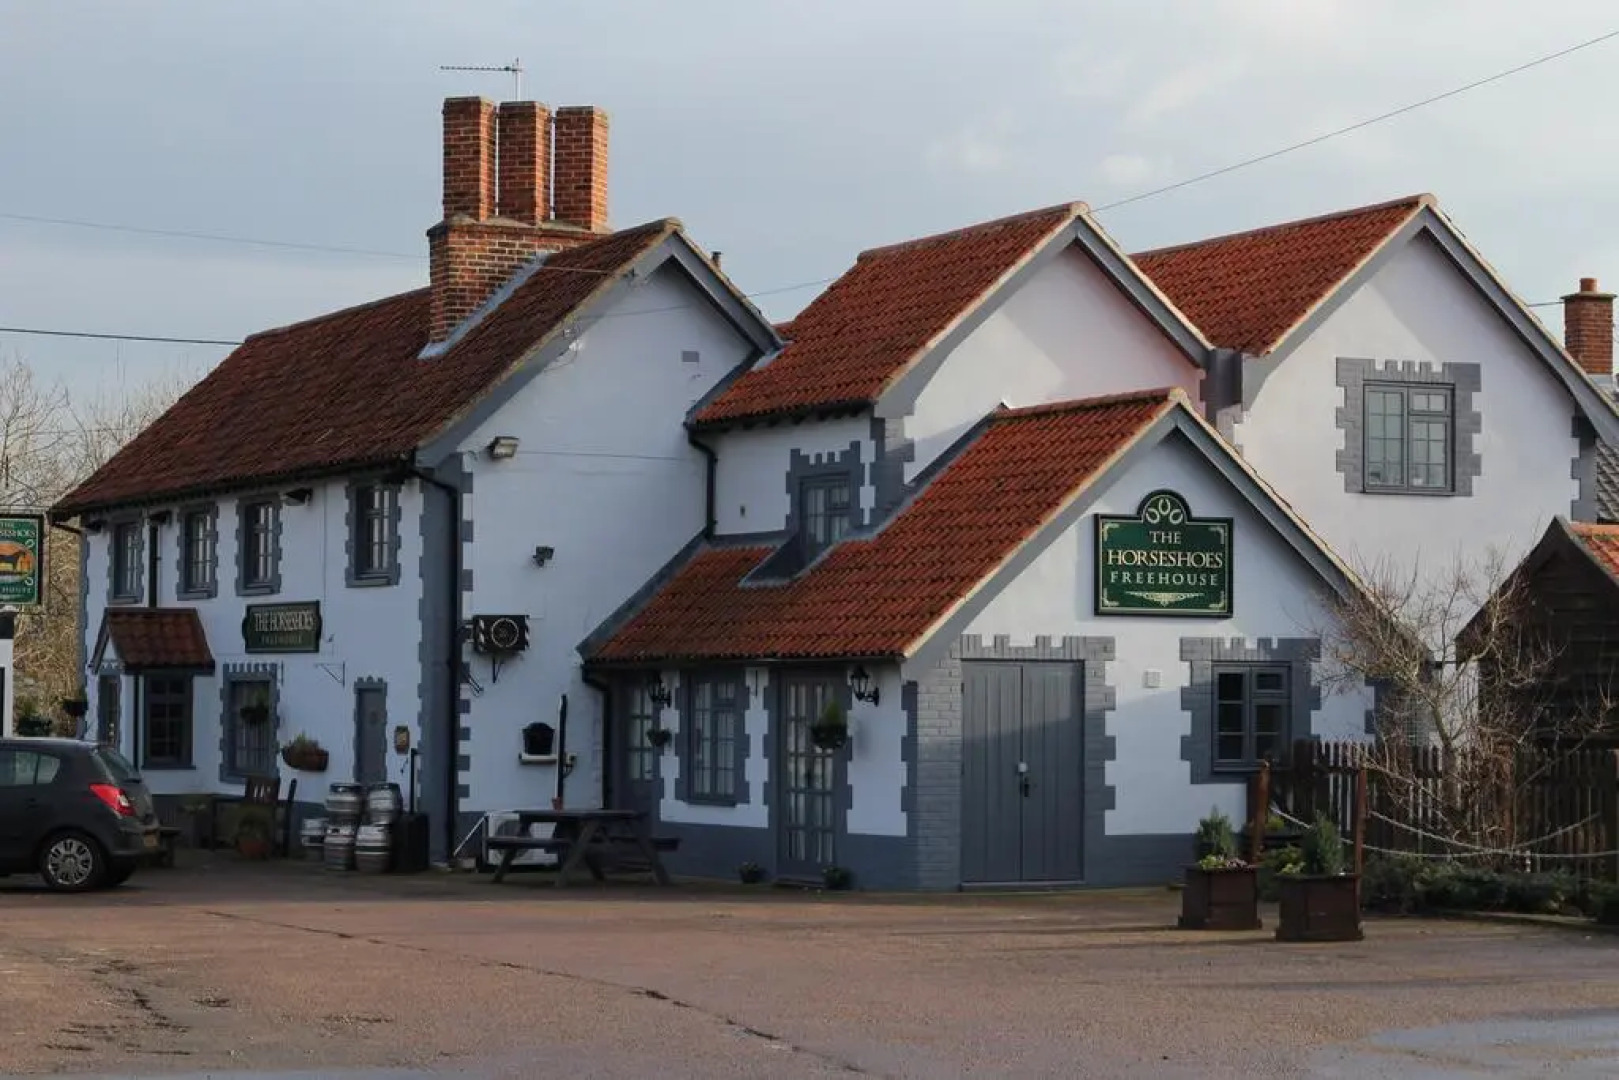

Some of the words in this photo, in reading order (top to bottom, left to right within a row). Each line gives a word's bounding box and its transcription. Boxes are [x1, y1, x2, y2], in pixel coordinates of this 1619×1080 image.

[1149, 531, 1182, 545] THE
[1107, 549, 1223, 569] HORSESHOES
[1110, 571, 1219, 586] FREEHOUSE
[253, 612, 268, 631] THE
